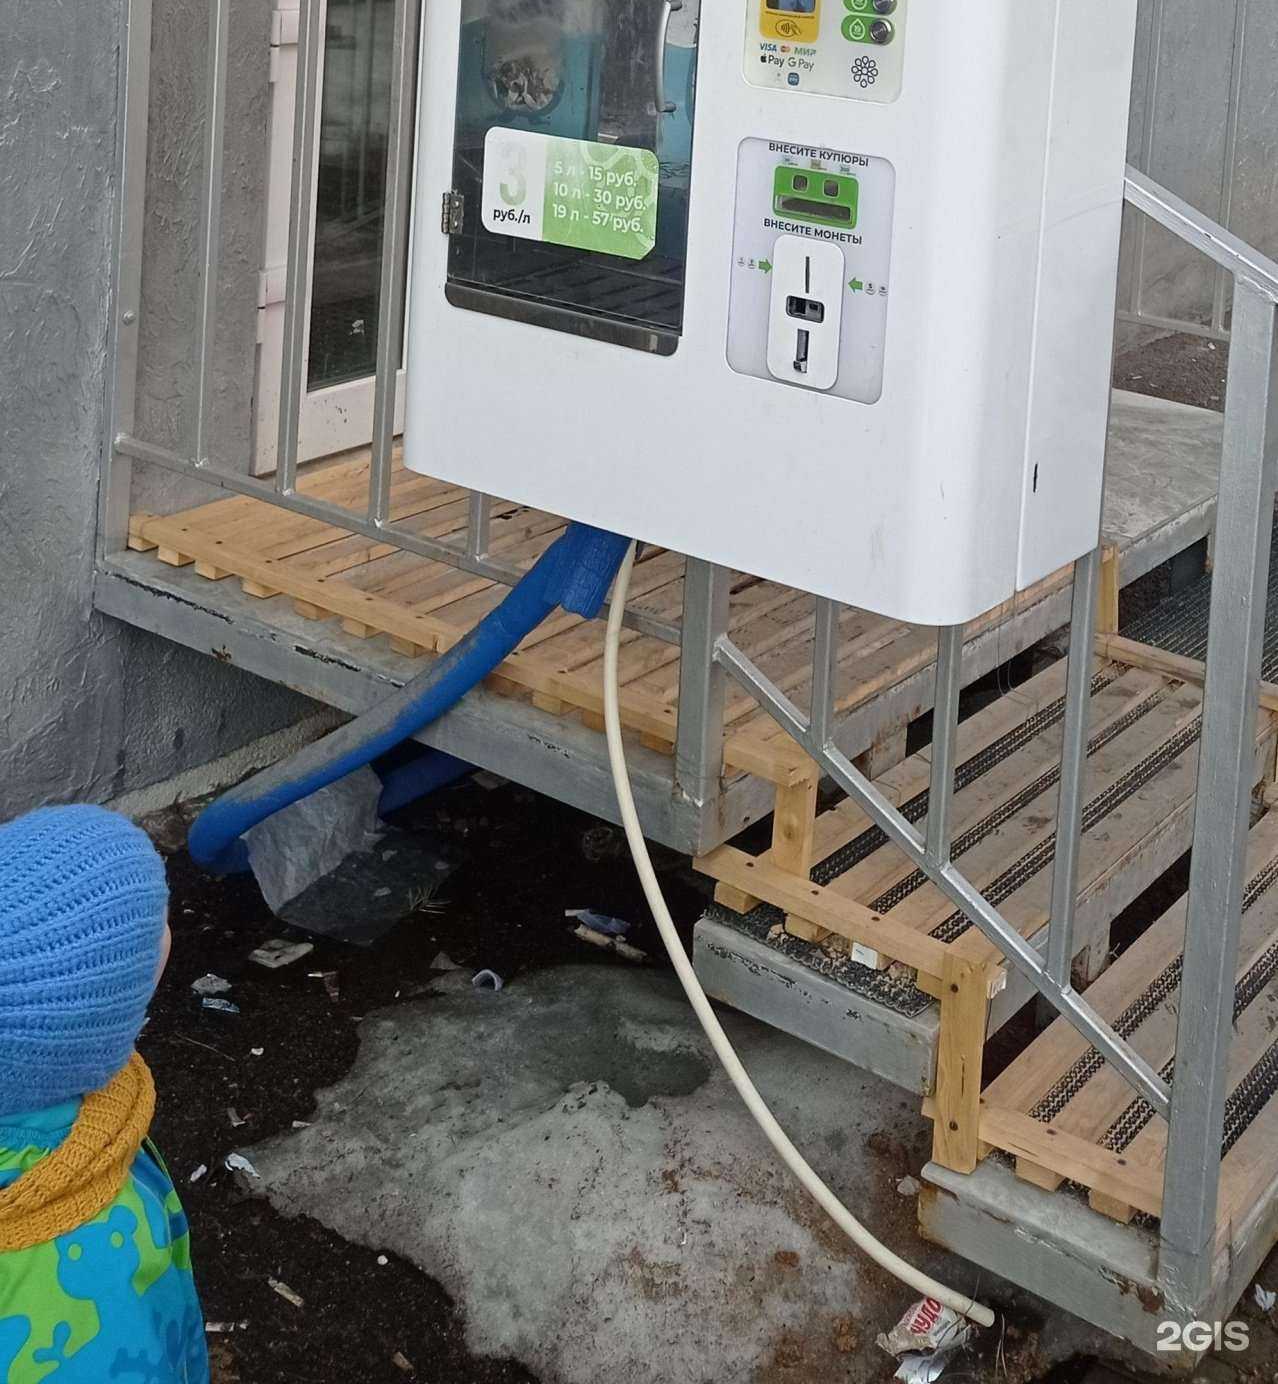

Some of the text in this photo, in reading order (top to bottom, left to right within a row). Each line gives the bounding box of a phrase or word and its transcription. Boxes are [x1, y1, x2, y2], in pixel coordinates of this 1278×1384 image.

[760, 42, 778, 52] VISA
[768, 55, 785, 68] Pay
[798, 59, 815, 72] Pay
[768, 142, 817, 158] ВНЕСИТЕ
[819, 150, 869, 167] КУПЮРЫ
[553, 161, 564, 174] 5
[589, 165, 603, 180] 15
[605, 170, 637, 187] руб.
[553, 182, 568, 196] 10
[593, 187, 612, 204] 30
[615, 194, 647, 211] руб.
[493, 208, 531, 224] руб./л
[552, 203, 567, 218] 19
[592, 210, 610, 226] 57
[612, 215, 644, 233] руб.
[763, 218, 863, 245] ВНЕСИТЕ МОНЕТЫ
[910, 1296, 944, 1334] ЧУДО
